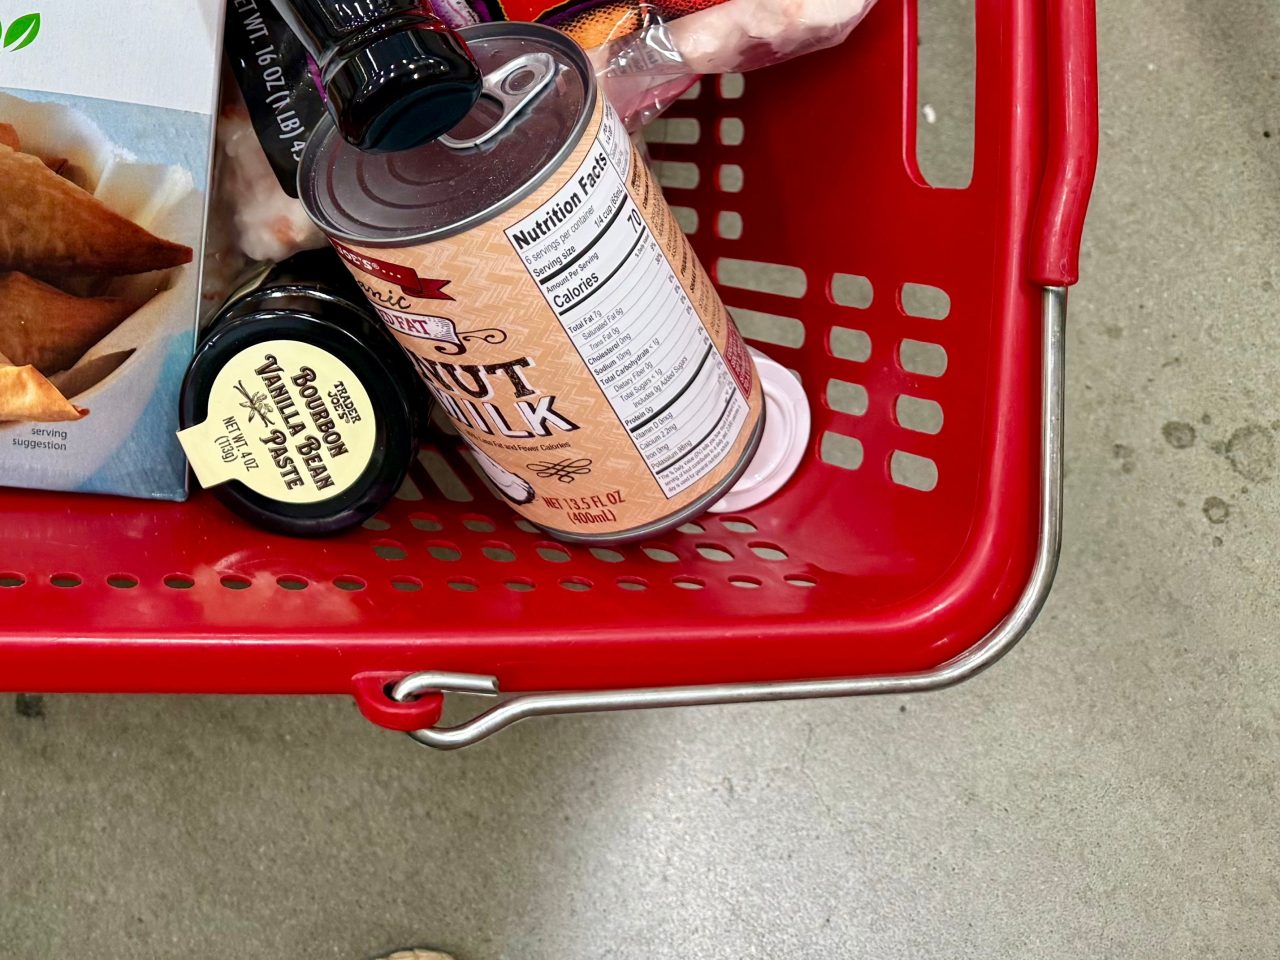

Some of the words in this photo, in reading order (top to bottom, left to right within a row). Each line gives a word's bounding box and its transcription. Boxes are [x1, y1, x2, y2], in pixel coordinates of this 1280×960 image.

[242, 12, 270, 45] WT.
[254, 44, 275, 67] 16
[262, 67, 285, 92] OZ
[265, 90, 291, 115] (1
[276, 111, 305, 140] LB)
[512, 191, 582, 250] Nutrition
[577, 151, 608, 197] Facts
[524, 254, 533, 265] 6
[531, 236, 561, 263] servings
[559, 228, 571, 245] per
[570, 204, 596, 234] container
[532, 253, 563, 278] Serving
[562, 244, 577, 260] size
[593, 213, 605, 229] 1/4
[601, 204, 613, 224] cup
[546, 273, 570, 295] Amount
[568, 266, 580, 281] Per
[579, 250, 600, 274] Serving
[552, 271, 600, 309] Calories
[626, 207, 642, 235] 70
[392, 314, 432, 337] FAT
[567, 321, 585, 335] Total
[583, 314, 595, 327] Fat
[593, 308, 603, 321] 7g
[581, 317, 609, 341] Saturated
[606, 312, 617, 324] Fat
[587, 341, 621, 366] Cholesterol
[618, 331, 633, 345] 0mg
[601, 331, 613, 344] Fat
[593, 358, 618, 376] Sodium
[616, 347, 633, 363] 10mg
[600, 372, 617, 387] Total
[615, 348, 651, 378] Carbohydrate
[613, 375, 634, 394] Dietary
[631, 365, 646, 381] Fiber
[620, 388, 635, 402] Total
[632, 376, 653, 394] Sugars
[632, 389, 655, 409] Includes
[660, 369, 676, 388] Added
[673, 355, 689, 376] Sugars
[290, 365, 350, 459] BOURBON
[327, 390, 348, 421] JOE'S
[333, 380, 362, 425] TRADER
[433, 395, 581, 439] MILK
[222, 415, 241, 435] NET
[254, 353, 307, 437] VANILLA
[295, 434, 336, 492] BEAN
[624, 411, 647, 427] Protein
[632, 423, 656, 441] Vitamin
[12, 437, 67, 451] suggestion
[31, 427, 68, 441] serving
[213, 434, 239, 463] (113g)
[231, 431, 249, 452] WT.
[505, 442, 518, 451] and
[518, 444, 540, 452] Fewer
[540, 441, 572, 452] Calories
[639, 432, 662, 452] Calcium
[660, 421, 679, 439] 2.2mg
[240, 451, 253, 459] 4
[243, 458, 259, 472] OZ
[259, 428, 305, 491] PASTE
[644, 449, 658, 461] Iron
[650, 449, 679, 471] Potassium
[543, 495, 562, 512] NET
[562, 496, 592, 512] 13.5
[592, 495, 608, 509] FL
[609, 490, 626, 506] OZ
[567, 508, 618, 526] (400mL)
